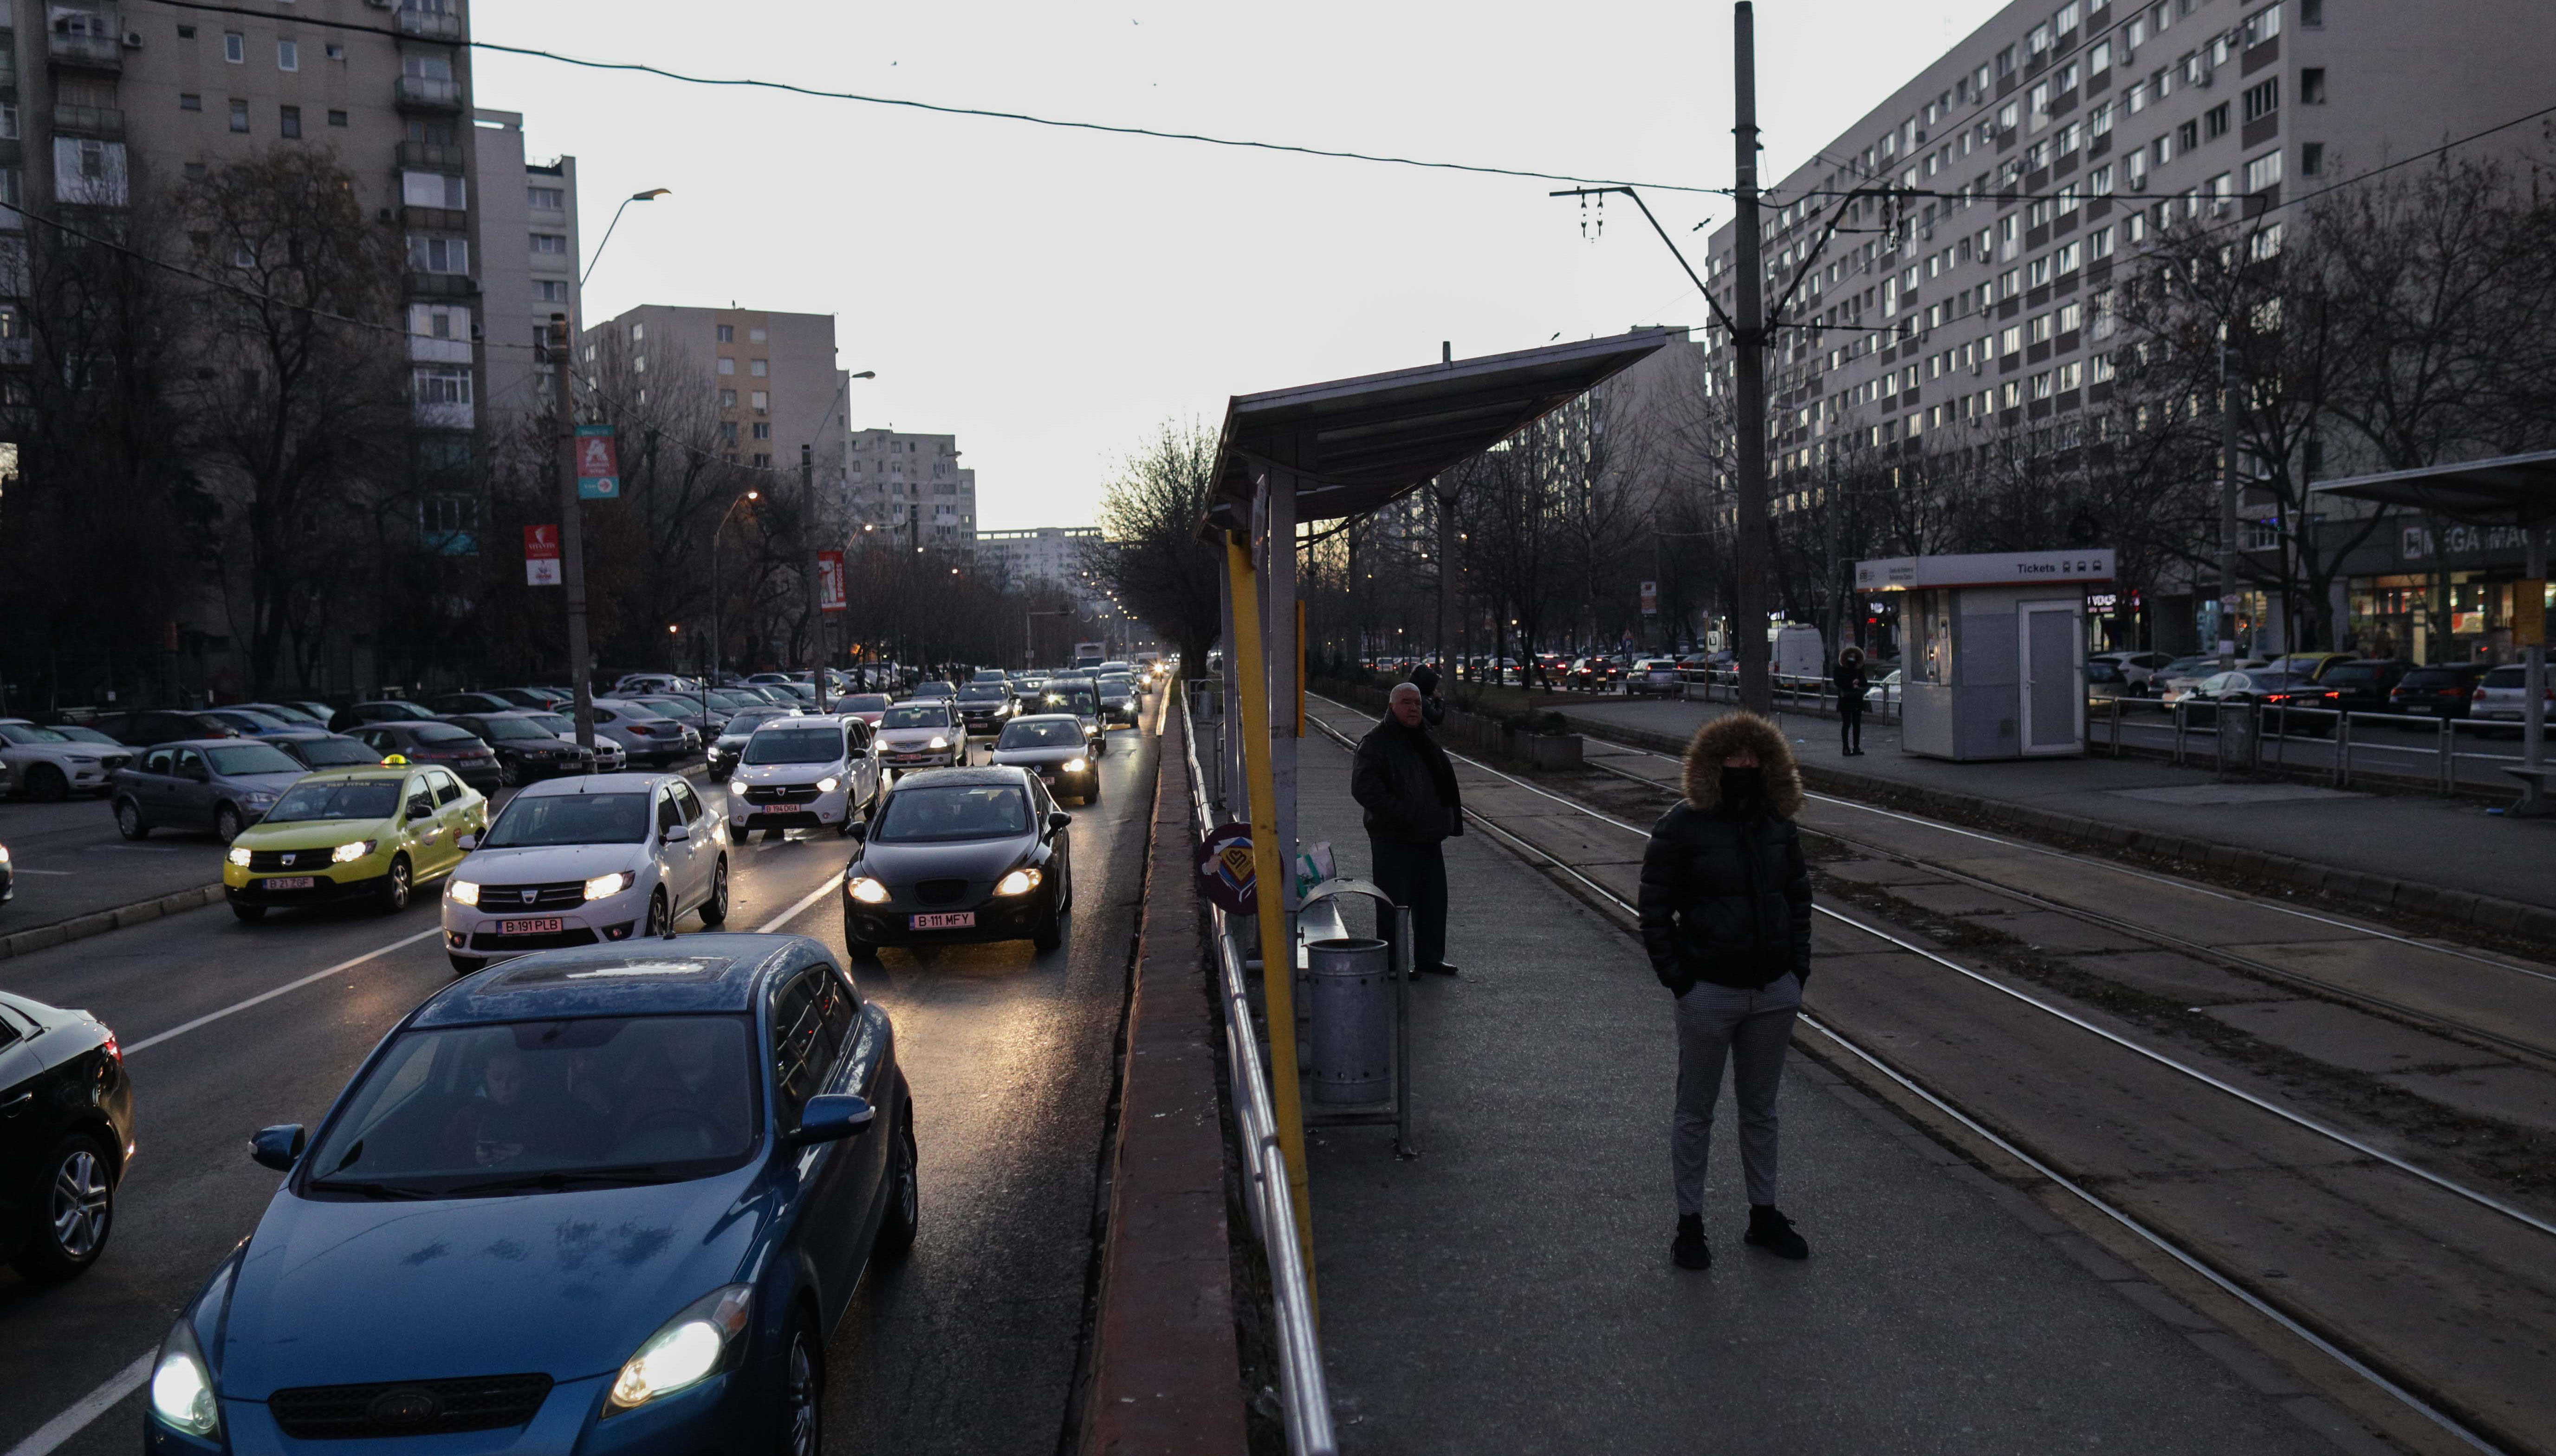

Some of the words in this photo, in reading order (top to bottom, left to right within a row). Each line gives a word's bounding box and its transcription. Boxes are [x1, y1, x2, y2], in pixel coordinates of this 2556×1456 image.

[2017, 563, 2056, 574] Tickets
[270, 879, 276, 888] B
[506, 922, 513, 932] B
[518, 921, 532, 932] 191
[535, 919, 558, 931] PLB
[919, 916, 927, 926] B
[930, 915, 942, 926] 111
[946, 913, 969, 925] MFY
